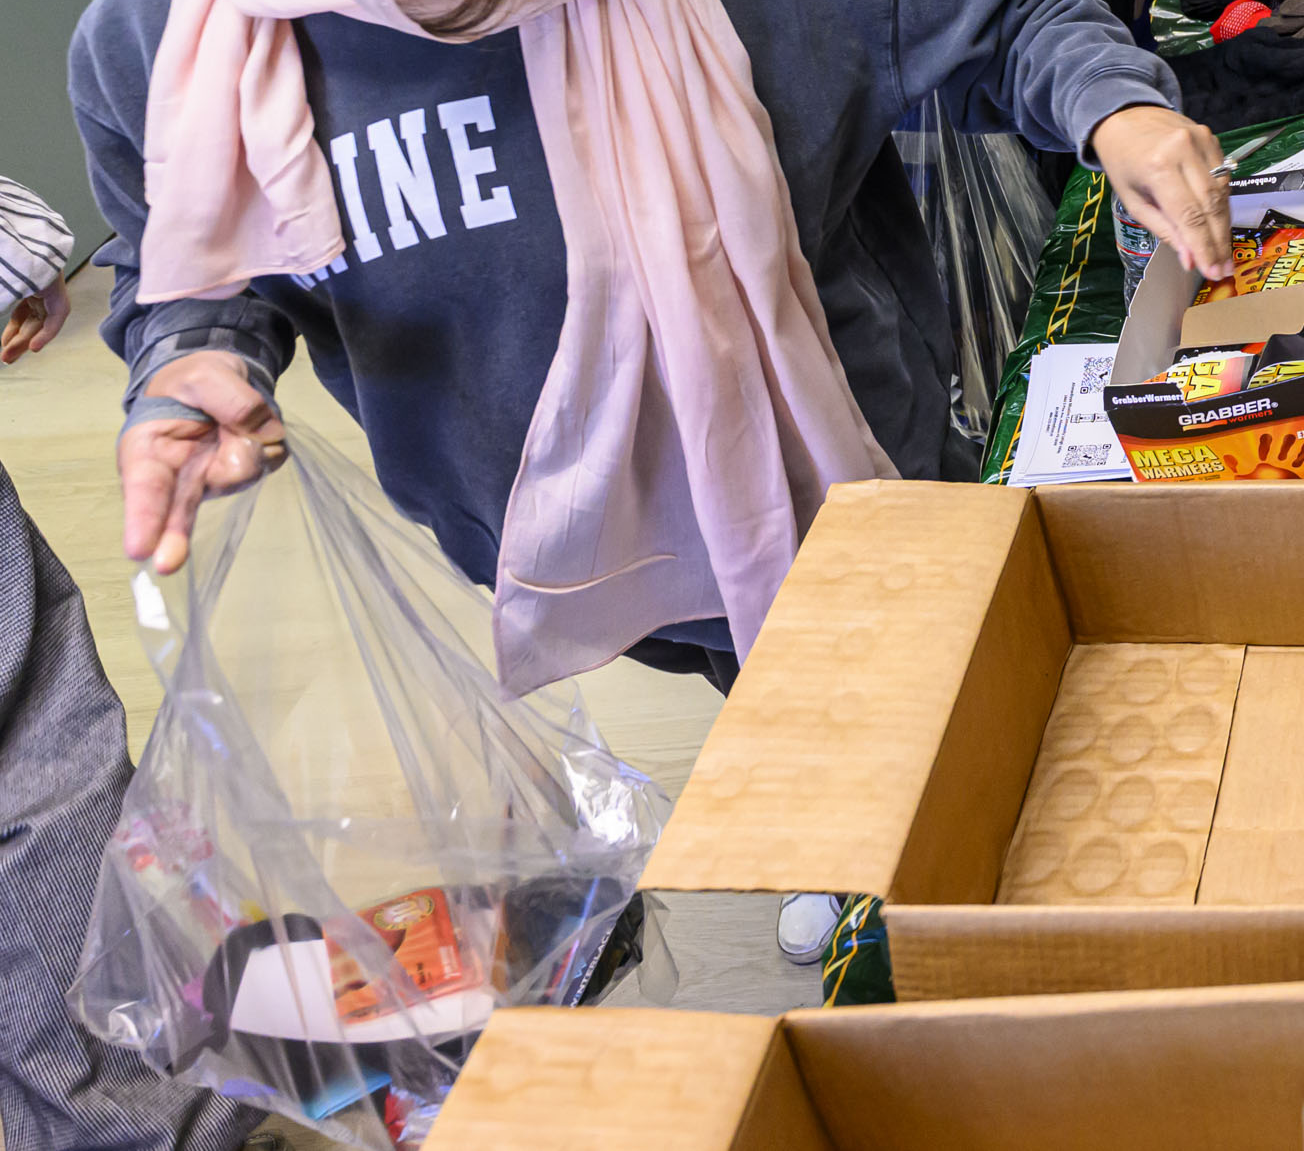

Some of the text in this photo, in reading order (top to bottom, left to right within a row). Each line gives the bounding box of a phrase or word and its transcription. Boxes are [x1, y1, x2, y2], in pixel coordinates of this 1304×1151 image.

[289, 95, 517, 291] INE
[1229, 410, 1273, 424] warmers
[1130, 444, 1220, 470] MEGA
[1138, 461, 1225, 481] WARMERS
